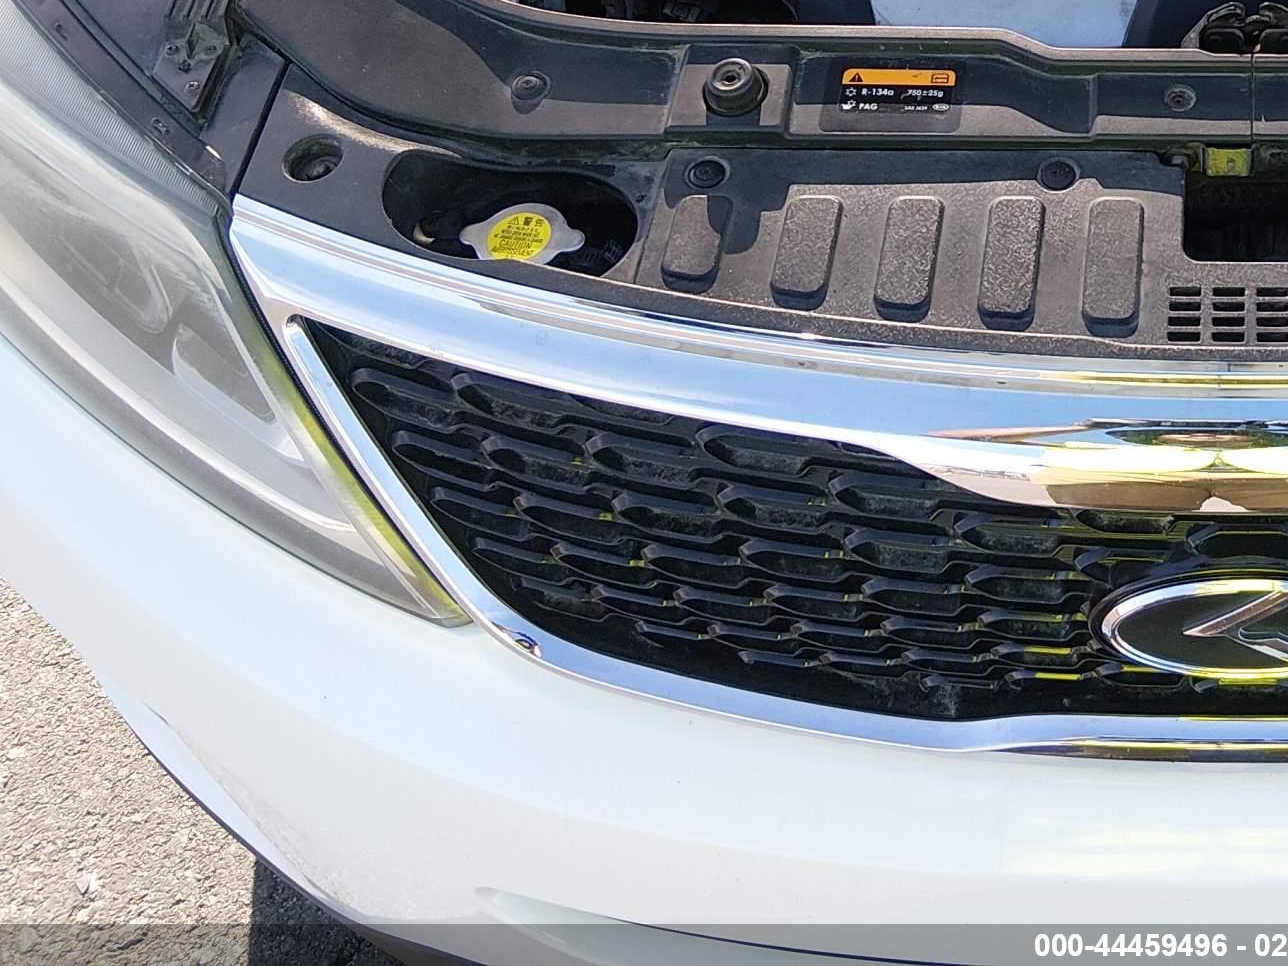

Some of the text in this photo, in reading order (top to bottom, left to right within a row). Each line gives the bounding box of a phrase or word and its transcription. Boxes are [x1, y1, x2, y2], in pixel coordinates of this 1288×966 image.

[861, 87, 895, 96] R-134a
[858, 103, 878, 111] PAG
[500, 238, 533, 250] CAUTION
